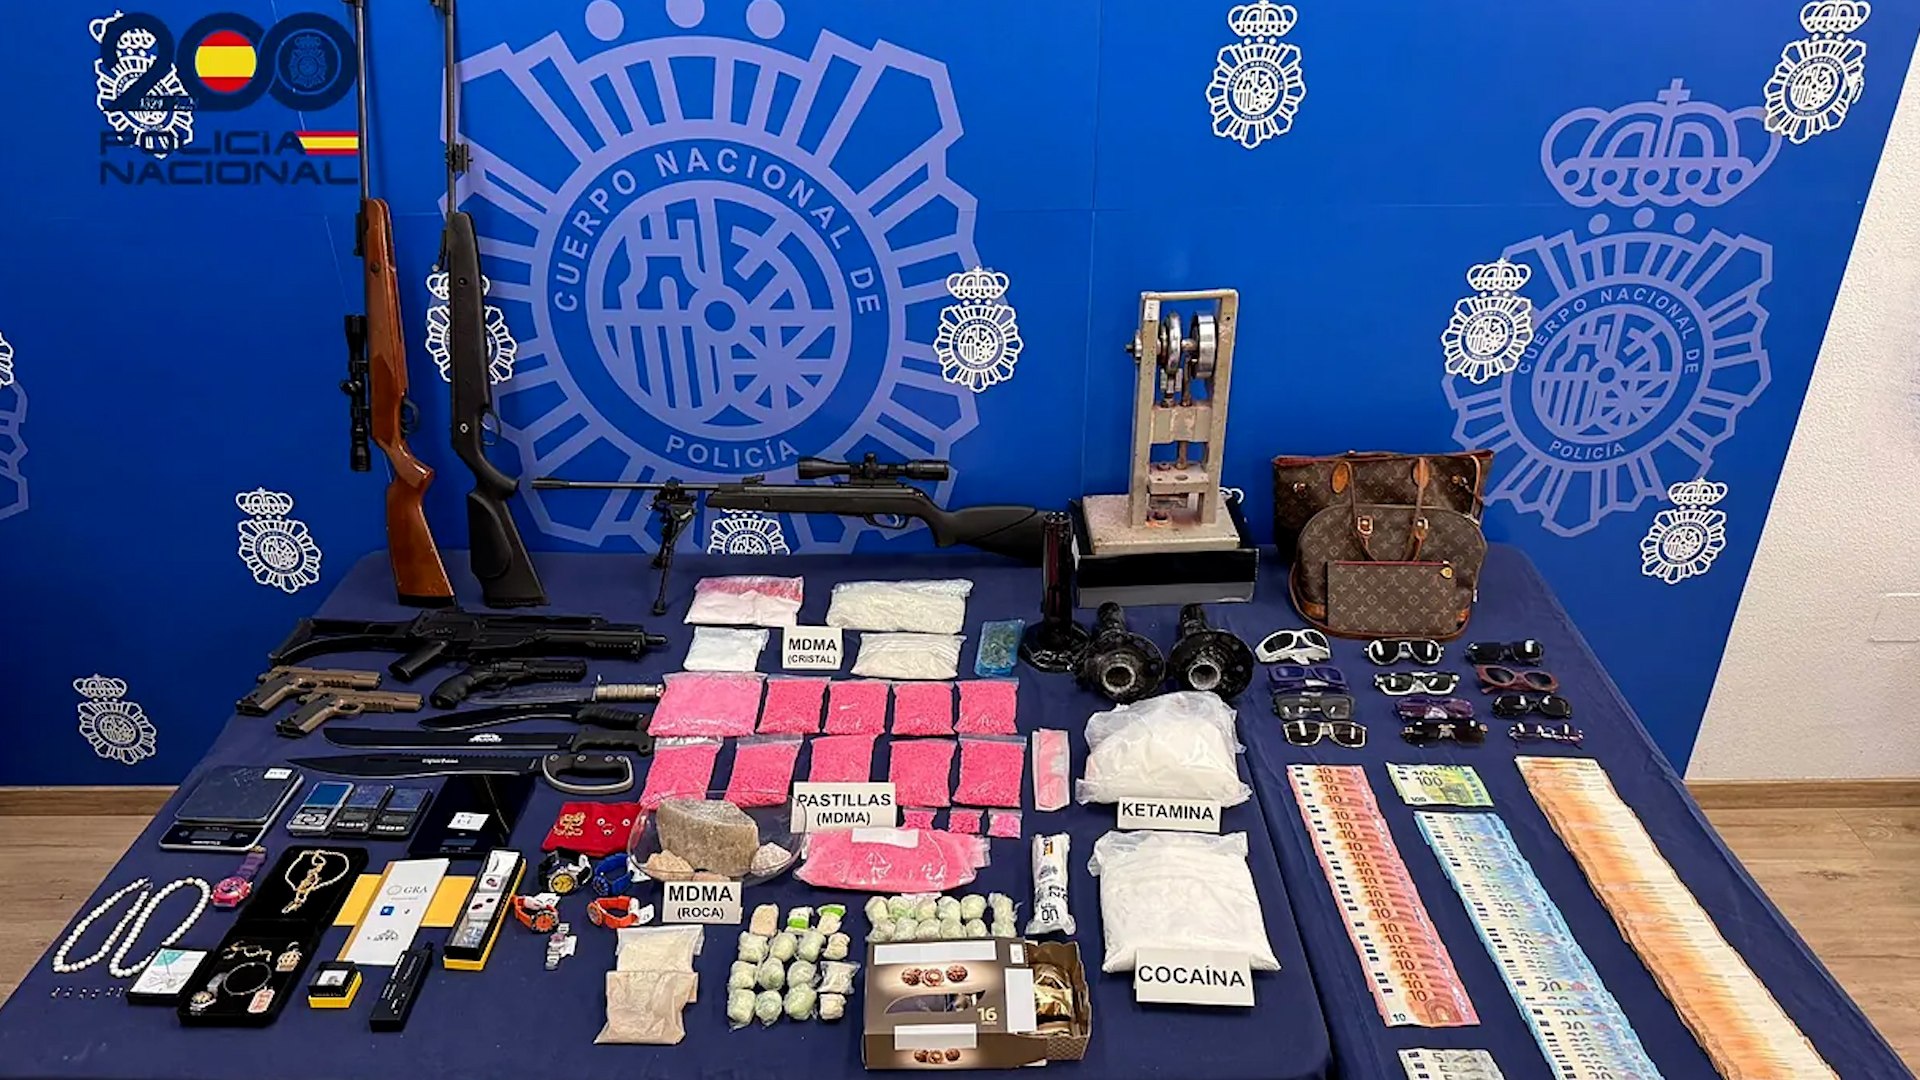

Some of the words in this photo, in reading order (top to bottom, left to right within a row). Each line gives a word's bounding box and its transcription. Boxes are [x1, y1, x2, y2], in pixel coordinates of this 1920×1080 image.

[554, 169, 637, 312] CUERPO
[654, 147, 850, 249] NACIONAL
[850, 266, 881, 315] DE
[1517, 298, 1587, 374] CUERPO
[1600, 287, 1696, 340] NACIONAL
[1684, 348, 1700, 375] DE
[665, 434, 799, 468] POLICÍA
[788, 638, 837, 651] MDMA
[787, 654, 837, 665] (CRISTAL)
[1318, 775, 1334, 783] 10
[1416, 776, 1443, 786] 100
[796, 793, 891, 807] PASTILLAS
[1327, 795, 1342, 803] 10
[1122, 803, 1215, 820] KETAMINA
[1333, 811, 1349, 820] 10
[816, 811, 871, 826] (MDMA)
[1340, 830, 1356, 839] 10
[1346, 842, 1363, 851] 10
[403, 886, 428, 894] GRA
[668, 885, 733, 902] MDMA
[677, 907, 724, 920] (ROCA)
[1374, 908, 1391, 919] 10
[1381, 923, 1399, 932] 10
[1385, 934, 1403, 943] 10
[1396, 959, 1415, 971] 10
[1138, 965, 1246, 987] COCAÍNA
[1538, 981, 1562, 992] 20
[1409, 990, 1427, 1001] 10
[976, 1006, 998, 1021] 16
[1393, 1013, 1406, 1022] 10
